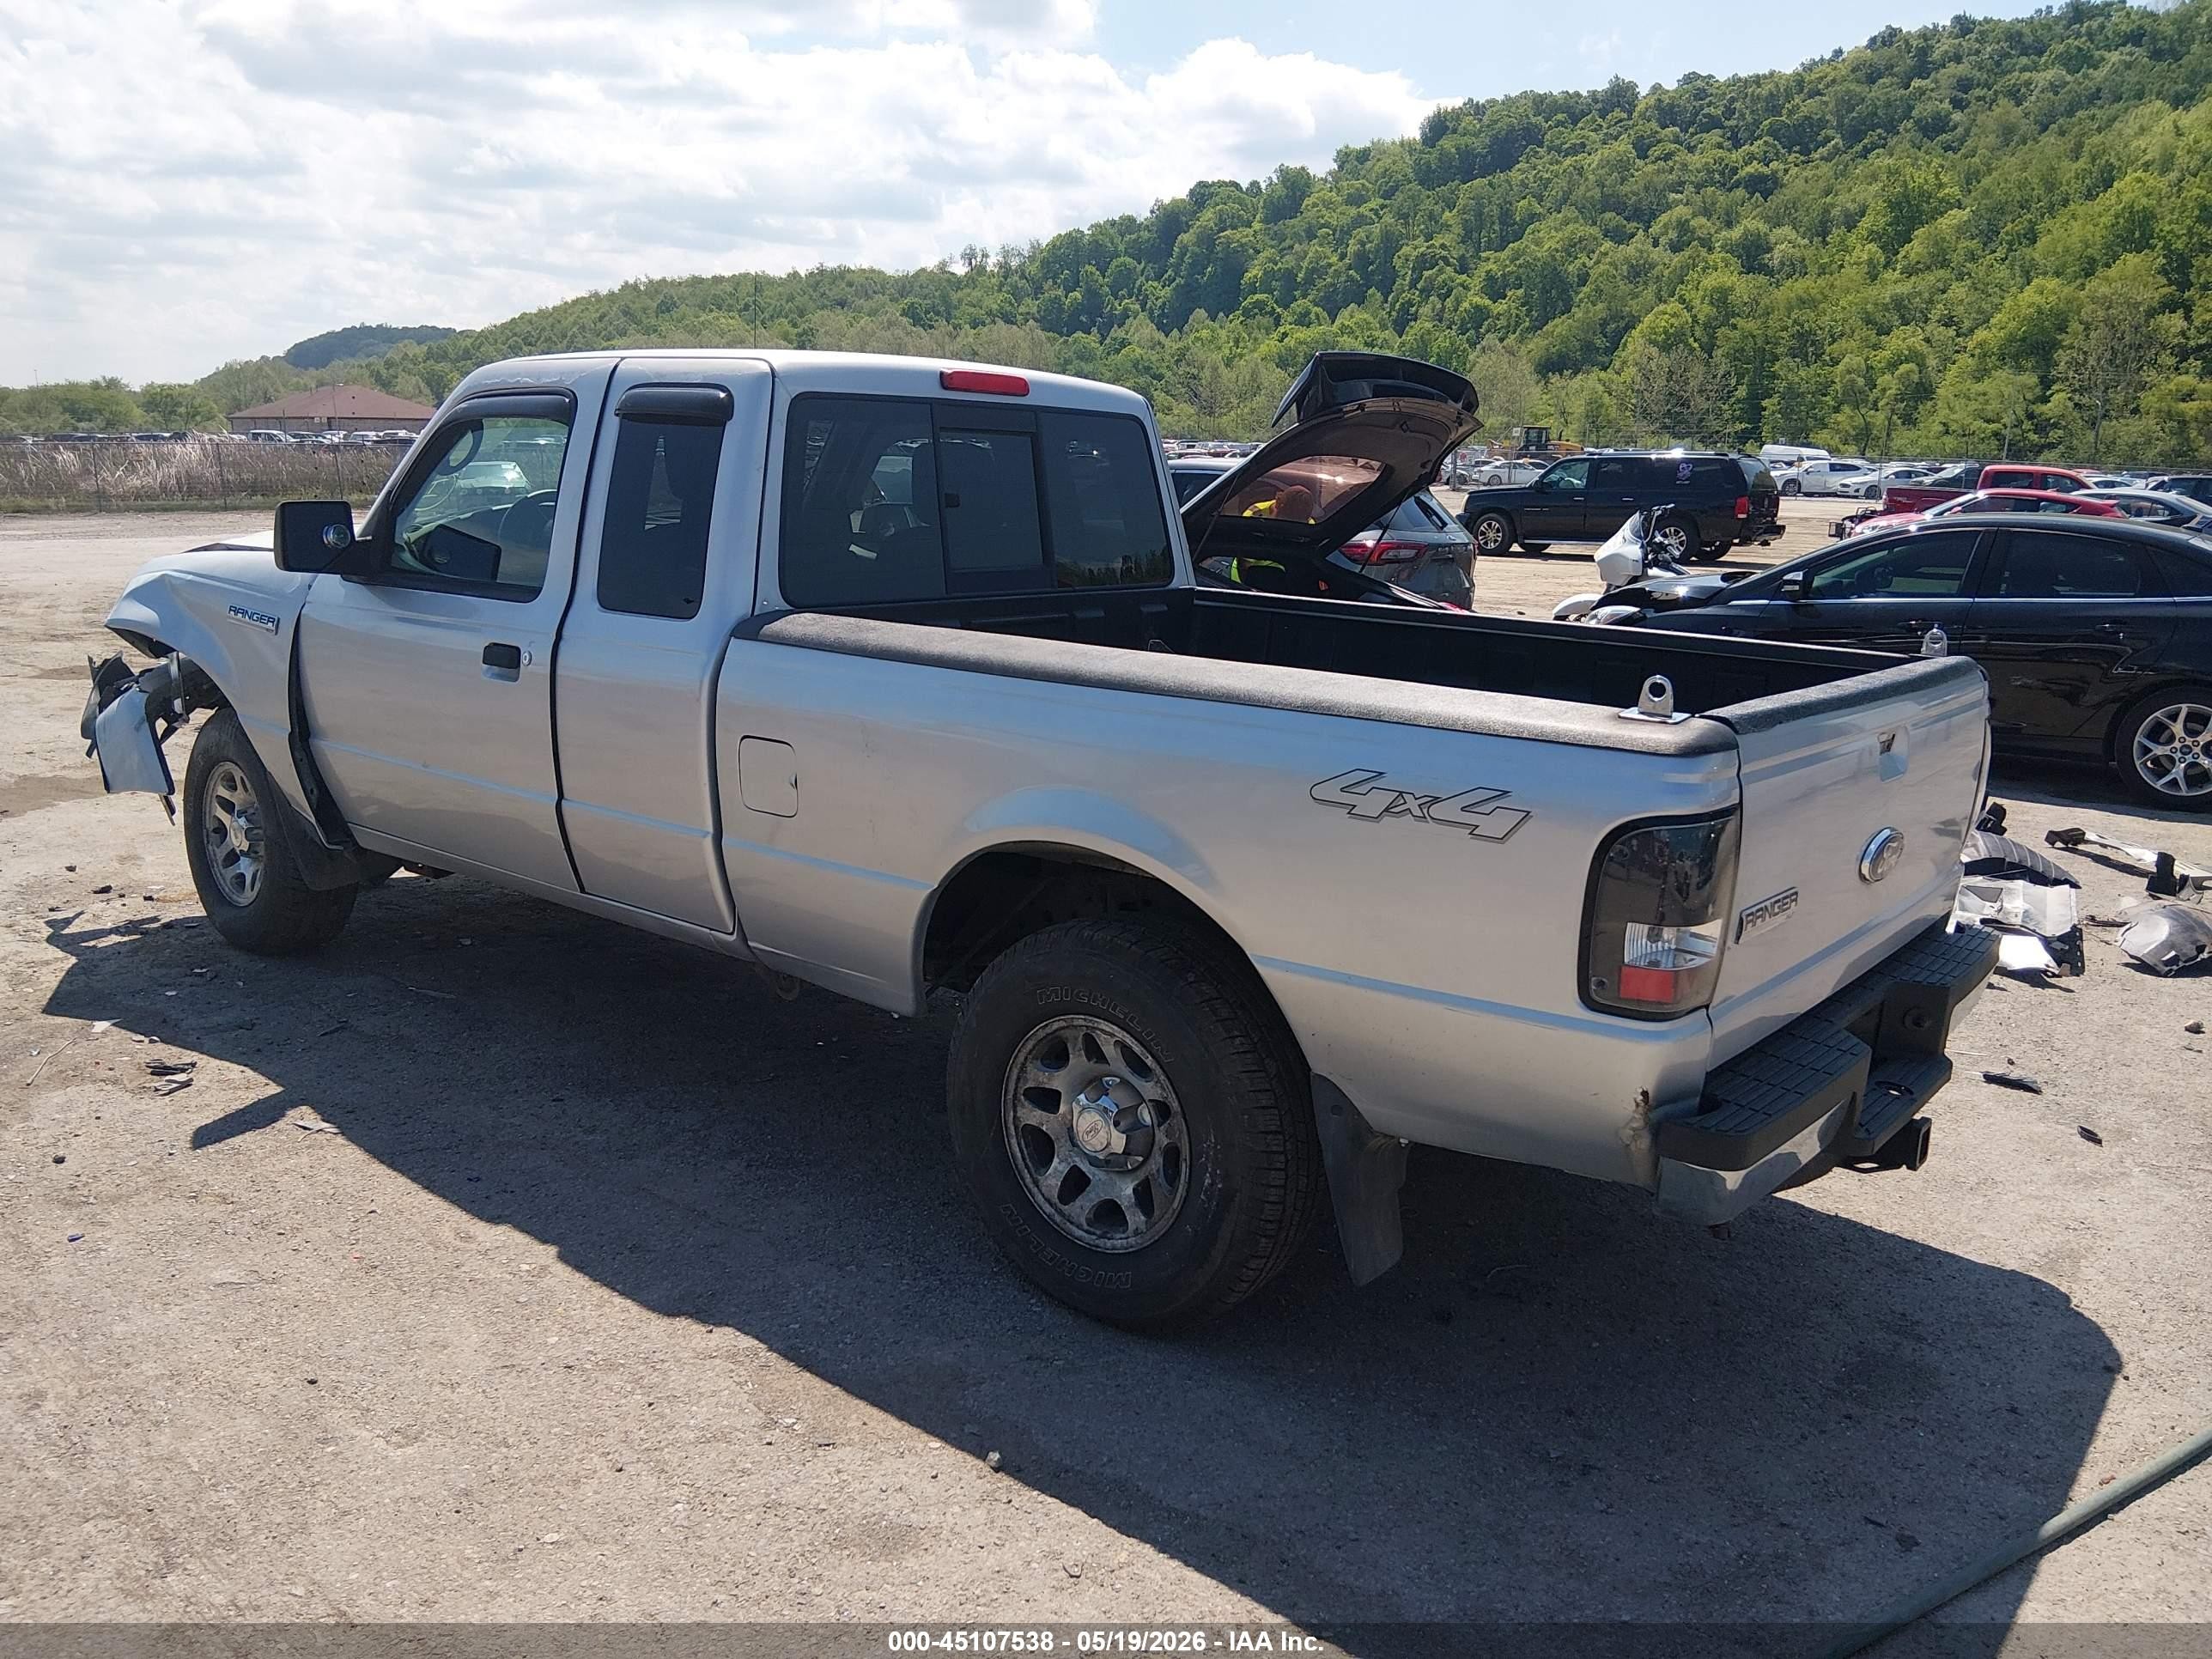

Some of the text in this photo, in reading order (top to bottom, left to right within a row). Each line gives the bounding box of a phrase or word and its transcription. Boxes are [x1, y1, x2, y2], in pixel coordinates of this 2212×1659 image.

[228, 605, 276, 628] RANGER
[1310, 769, 1533, 843] 4x4
[1744, 890, 1799, 933] RANGER
[1036, 987, 1175, 1063] MICHELIN
[1000, 1203, 1133, 1289] MICHELIN
